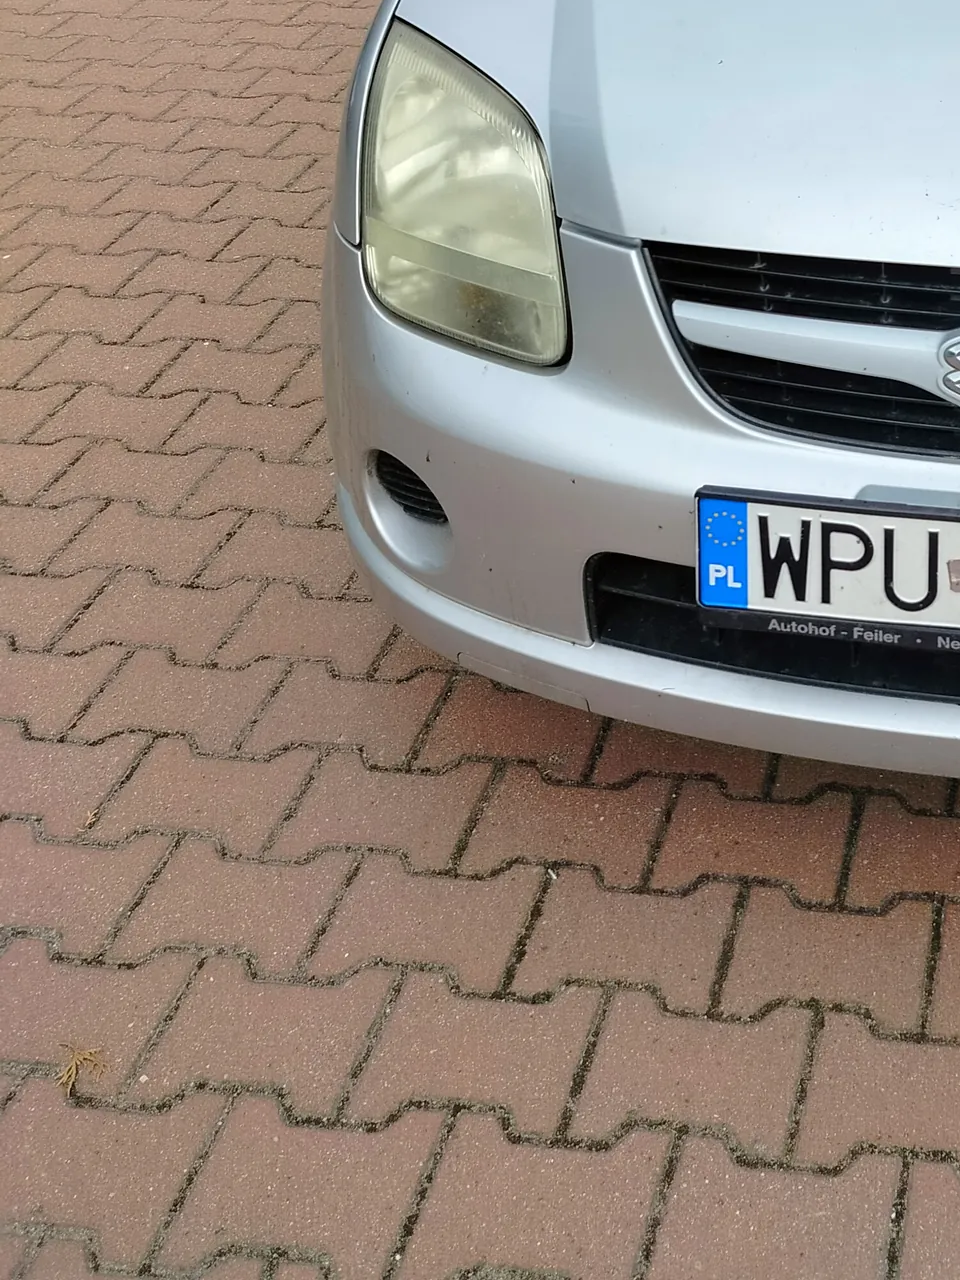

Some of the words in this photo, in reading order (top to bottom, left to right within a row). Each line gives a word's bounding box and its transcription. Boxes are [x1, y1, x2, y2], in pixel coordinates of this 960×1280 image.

[757, 513, 939, 612] WPU
[708, 564, 742, 588] PL
[768, 618, 837, 637] Autohof
[853, 627, 901, 644] Feiler
